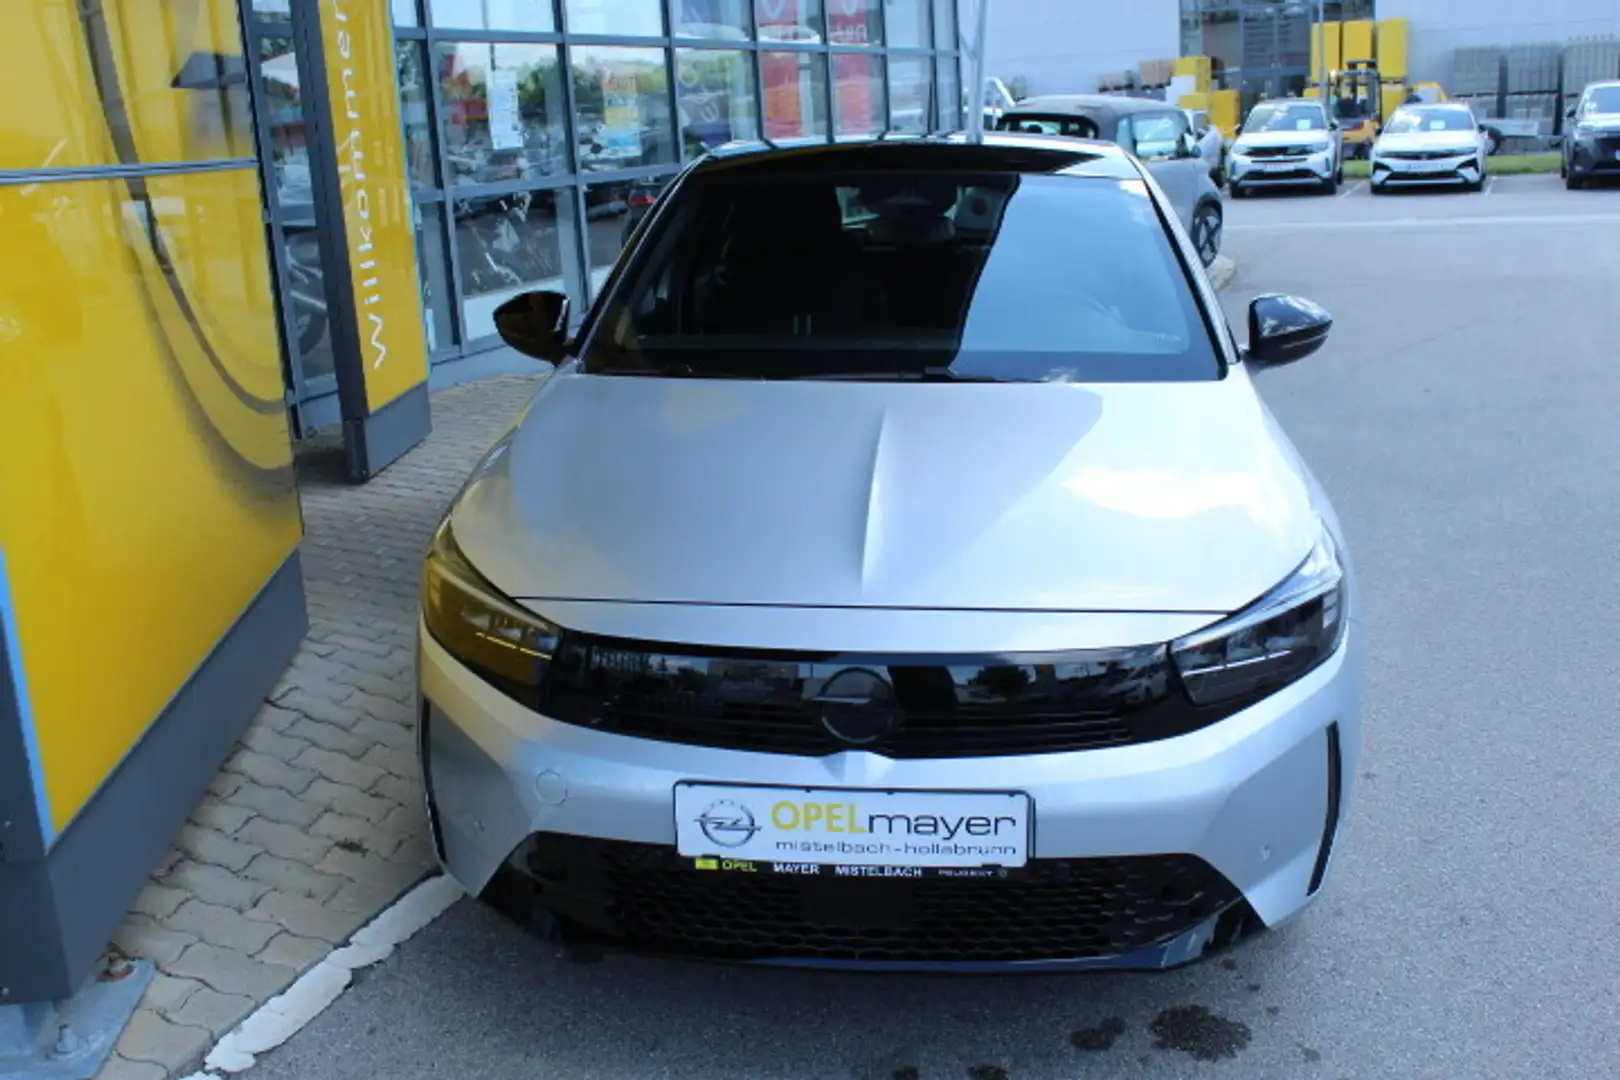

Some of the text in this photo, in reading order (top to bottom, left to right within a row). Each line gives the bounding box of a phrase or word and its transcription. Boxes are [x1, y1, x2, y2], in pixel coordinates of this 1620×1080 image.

[722, 860, 757, 872] OPEL
[773, 862, 820, 875] MAYER
[835, 865, 922, 877] MISTELBACH
